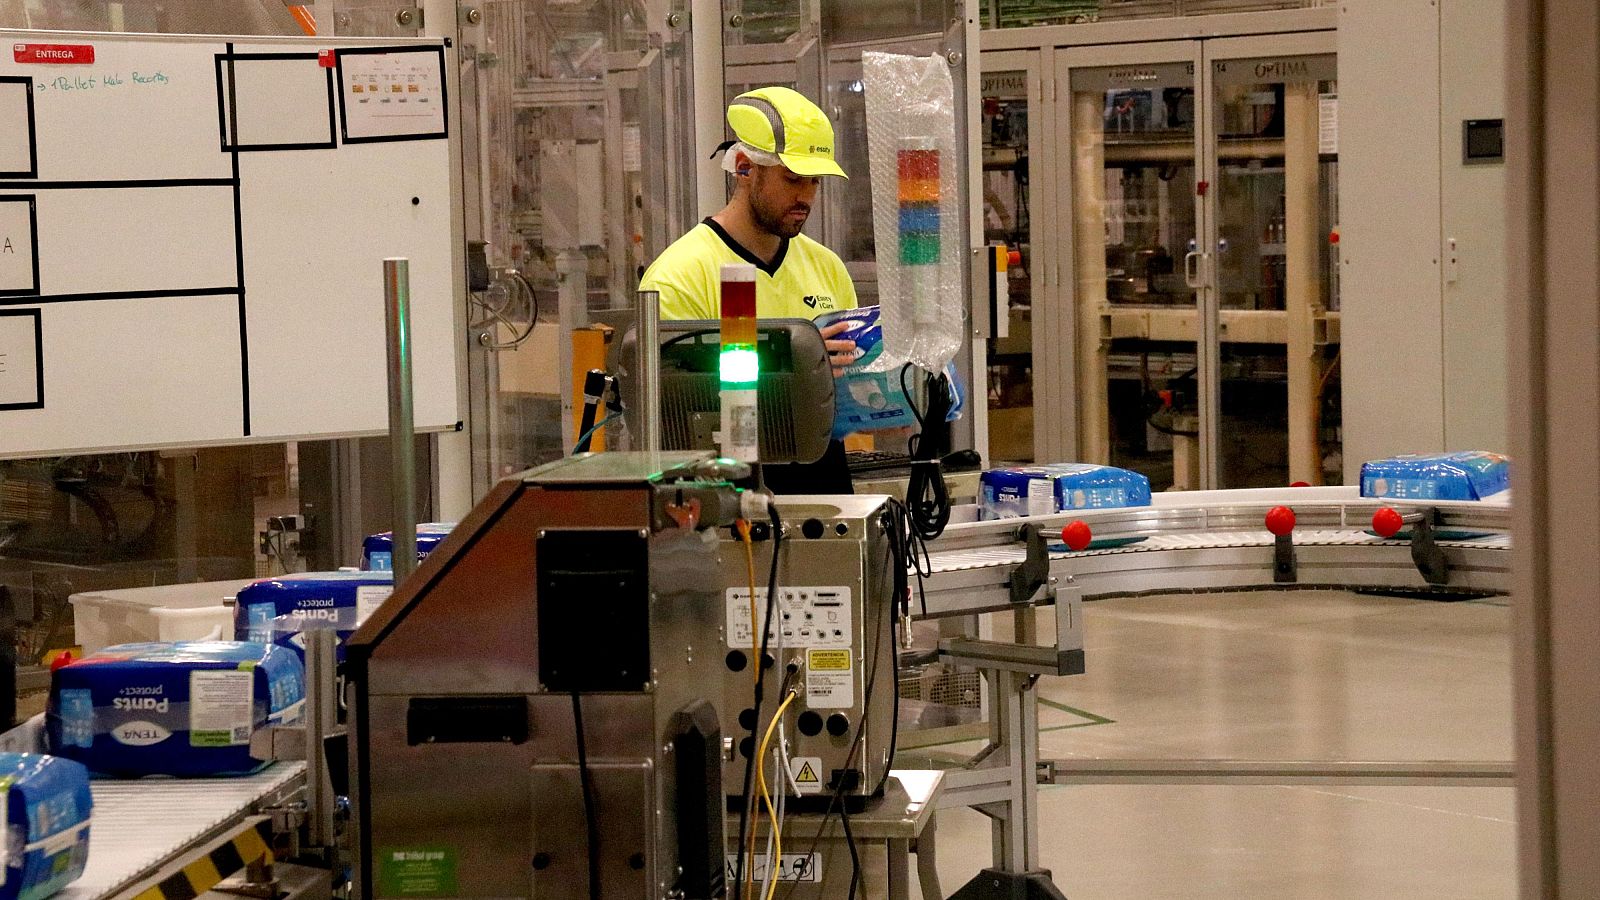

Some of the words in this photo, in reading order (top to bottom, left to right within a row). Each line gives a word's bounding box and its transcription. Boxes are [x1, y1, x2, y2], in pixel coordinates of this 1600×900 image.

[36, 50, 74, 59] ENTREGA
[1217, 63, 1226, 72] 14
[1255, 61, 1309, 78] OPTIMA
[297, 597, 334, 606] protect+
[291, 609, 339, 622] Pants
[119, 684, 163, 695] protect+
[112, 697, 169, 713] Pants
